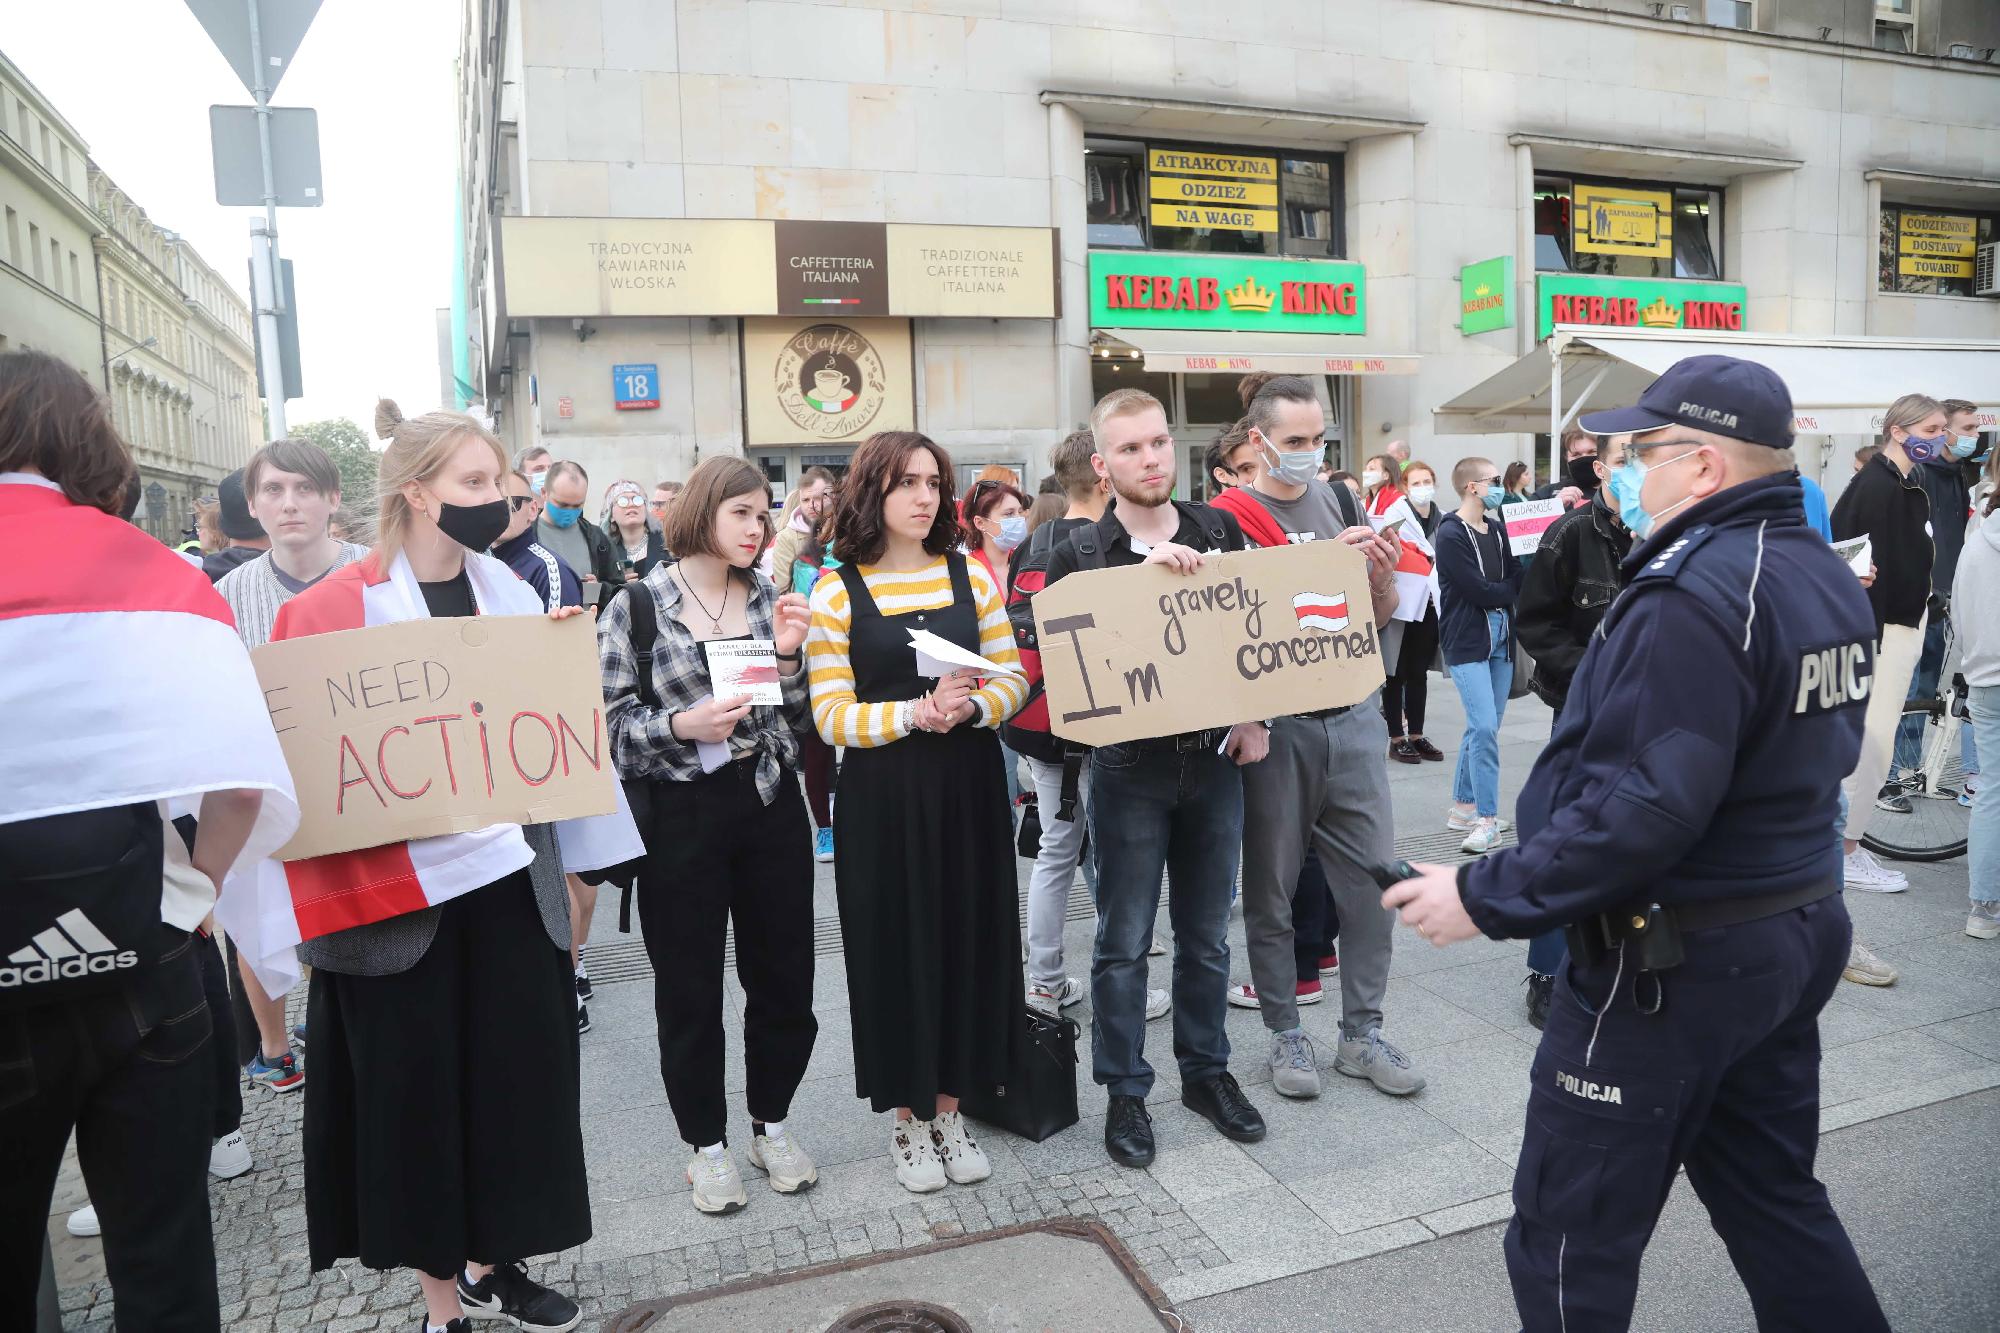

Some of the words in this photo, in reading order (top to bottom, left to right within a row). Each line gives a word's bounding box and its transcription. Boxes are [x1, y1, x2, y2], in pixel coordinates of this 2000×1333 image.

[1156, 154, 1271, 175] ATRAKCYJNA
[1175, 209, 1200, 223] NA
[1608, 208, 1655, 219] ZAPRASZAMY
[1907, 218, 1970, 233] CODZIENNE
[588, 242, 694, 256] TRADYCYJNA
[1913, 240, 1963, 254] DOSTAWY
[920, 248, 1024, 263] TRADIZIONALE
[598, 259, 688, 273] KAWIARNIA
[790, 256, 875, 270] CAFFETTERIA
[1914, 261, 1960, 275] TOWARU
[802, 271, 860, 284] ITALIANA
[926, 265, 1019, 279] CAFFETTERIA
[610, 276, 677, 290] WŁOSKA
[942, 281, 1006, 294] ITALIANA
[1106, 274, 1221, 311] KEBAB
[1281, 281, 1358, 316] KING
[1463, 297, 1487, 313] KEBAB
[1487, 294, 1504, 309] KING
[1552, 294, 1640, 327] KEBAB
[1682, 301, 1743, 331] KING
[1186, 358, 1217, 369] KEBAB
[1229, 357, 1251, 369] KING
[1326, 359, 1353, 371] KEBAB
[1364, 360, 1385, 371] KING
[624, 374, 649, 398] 18
[1678, 401, 1738, 429] POLICJA
[1977, 414, 1997, 426] EBAB
[1796, 416, 1818, 429] KING
[1158, 577, 1267, 655] gravely
[1236, 622, 1376, 680] concerned
[1043, 613, 1164, 724] I'm
[326, 659, 451, 717] NEED
[0, 950, 139, 987] adidas
[1555, 1070, 1622, 1105] POLICJA
[227, 1136, 242, 1148] FILA
